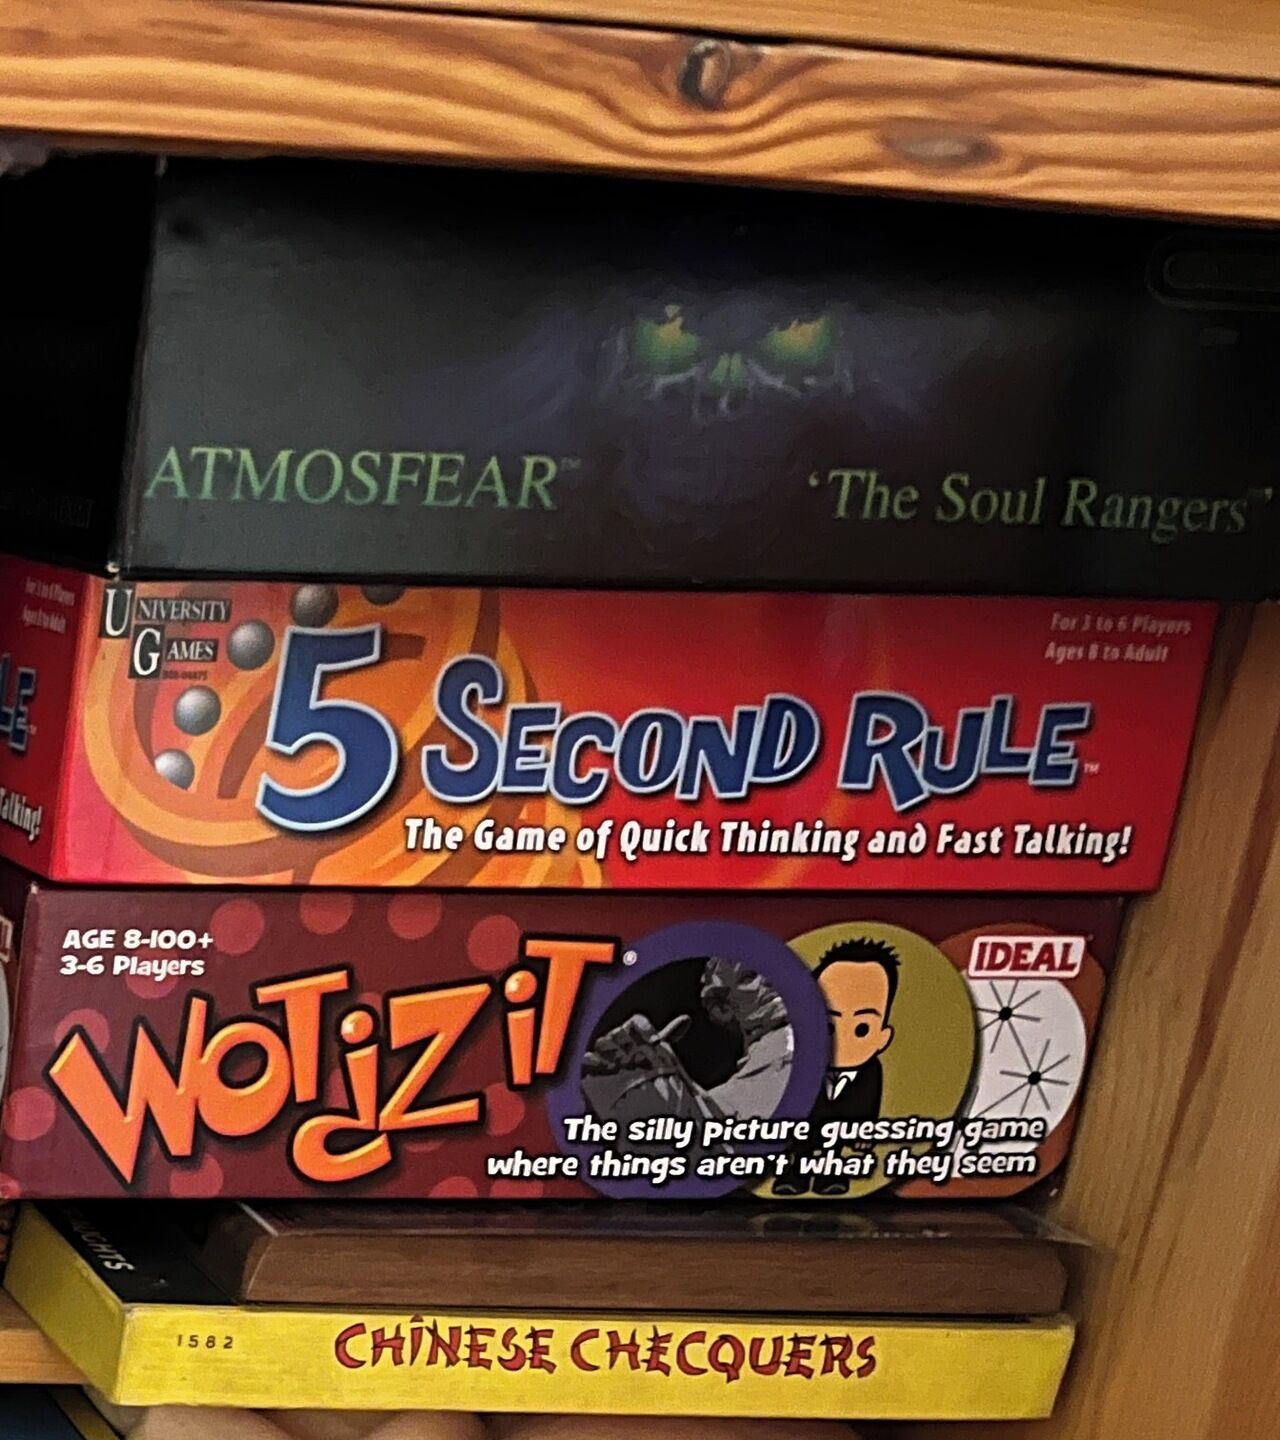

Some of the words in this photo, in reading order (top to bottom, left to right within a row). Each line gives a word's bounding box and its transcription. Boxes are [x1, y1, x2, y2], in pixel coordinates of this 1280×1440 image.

[936, 473, 1048, 526] Soul
[104, 586, 231, 637] UNIVERSITY
[133, 628, 214, 676] GAMES
[255, 622, 400, 832] 5
[421, 653, 820, 804] SECOND
[405, 819, 464, 850] The
[474, 819, 565, 852] Game
[577, 820, 614, 859] of
[620, 820, 709, 860] Quick
[720, 822, 858, 861] Thinking
[867, 824, 927, 854] and
[936, 825, 1003, 854] Fast
[1013, 825, 1132, 863] Talking!
[62, 929, 116, 950] AGE
[123, 929, 214, 951] 8-100+
[976, 941, 1079, 972] IDEAL
[61, 956, 104, 975] 3-6
[111, 955, 205, 981] Players
[564, 1117, 618, 1142] The
[628, 1117, 692, 1145] silly
[704, 1117, 810, 1147] picture
[821, 1118, 953, 1150] guessing
[964, 1119, 1044, 1148] game
[487, 1152, 578, 1177] where
[590, 1151, 685, 1183] things
[696, 1152, 788, 1177] aren't
[799, 1151, 878, 1177] what
[886, 1152, 950, 1182] they
[959, 1152, 1036, 1175] seem
[333, 1314, 557, 1374] CHINESE
[570, 1325, 876, 1384] CHECQUERS
